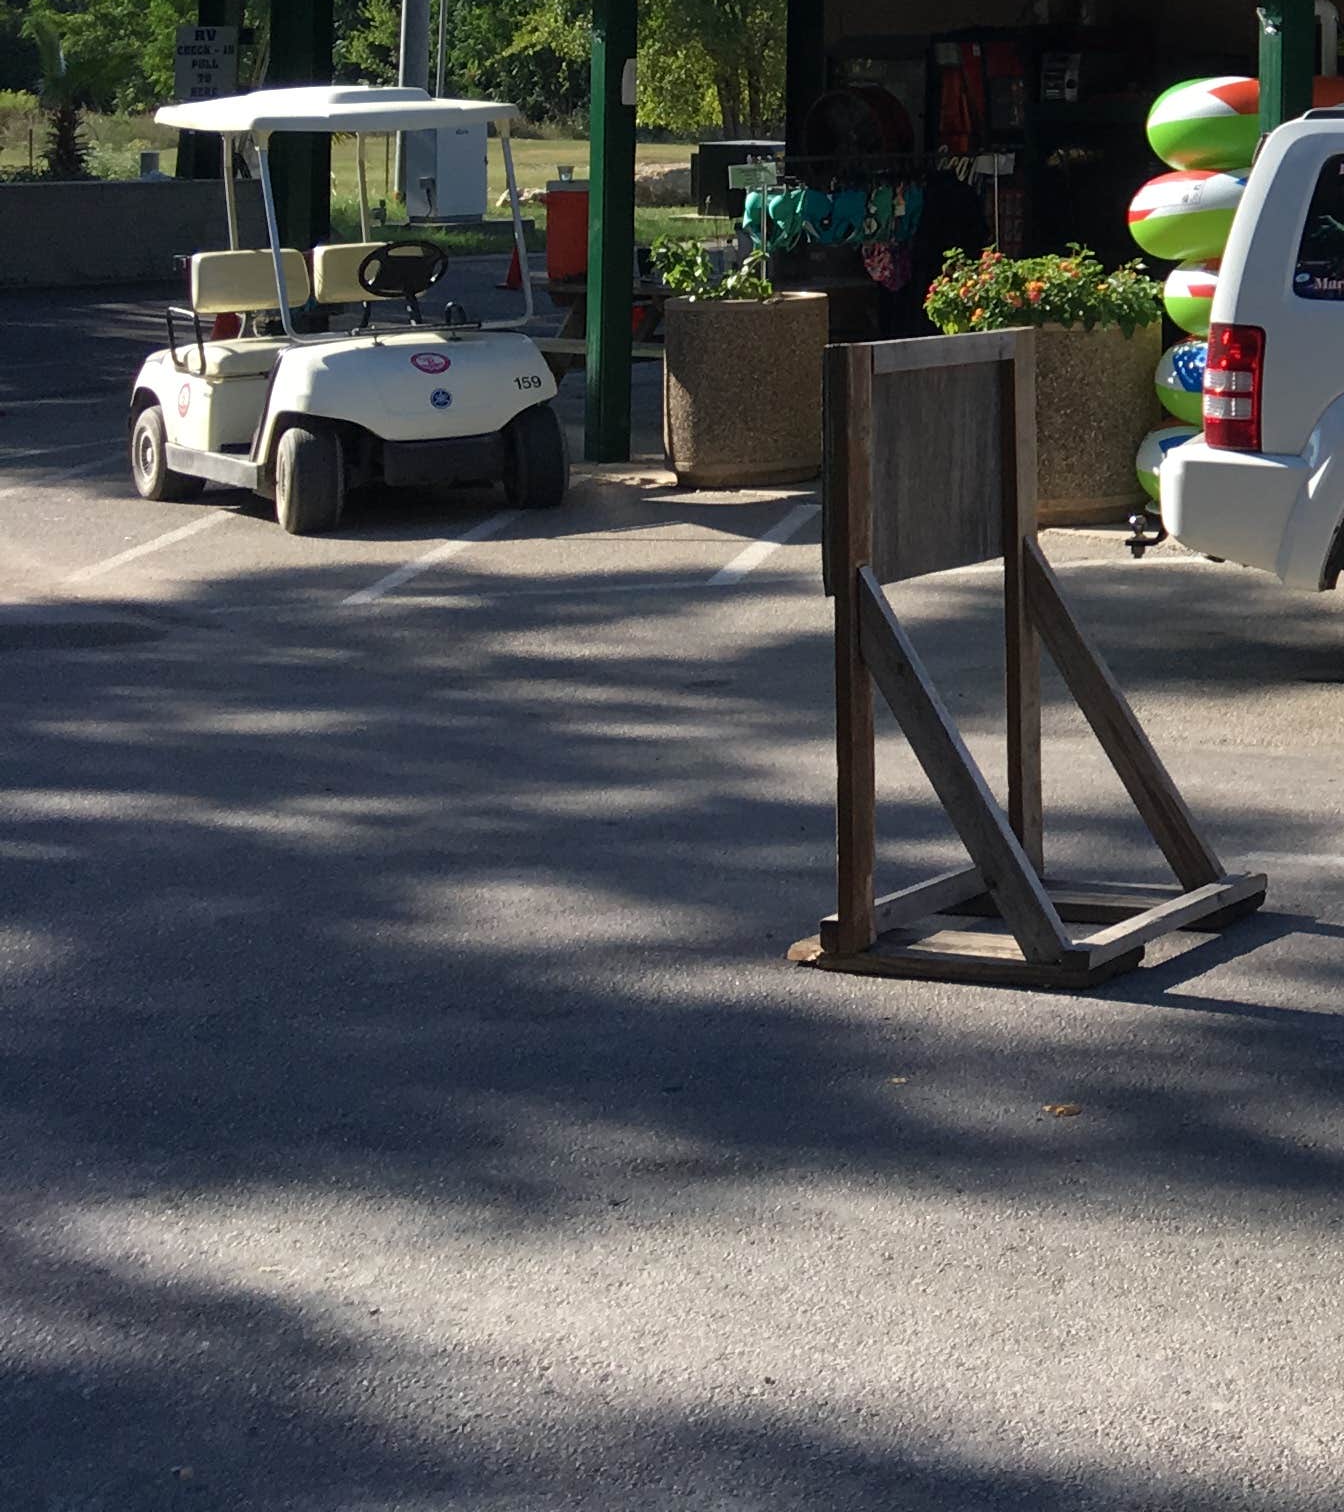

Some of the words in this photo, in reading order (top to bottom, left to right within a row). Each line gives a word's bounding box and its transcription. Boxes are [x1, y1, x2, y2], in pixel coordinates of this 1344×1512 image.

[194, 28, 217, 41] RV
[177, 44, 210, 55] CHECK
[191, 59, 219, 69] PULL
[513, 374, 543, 390] 159
